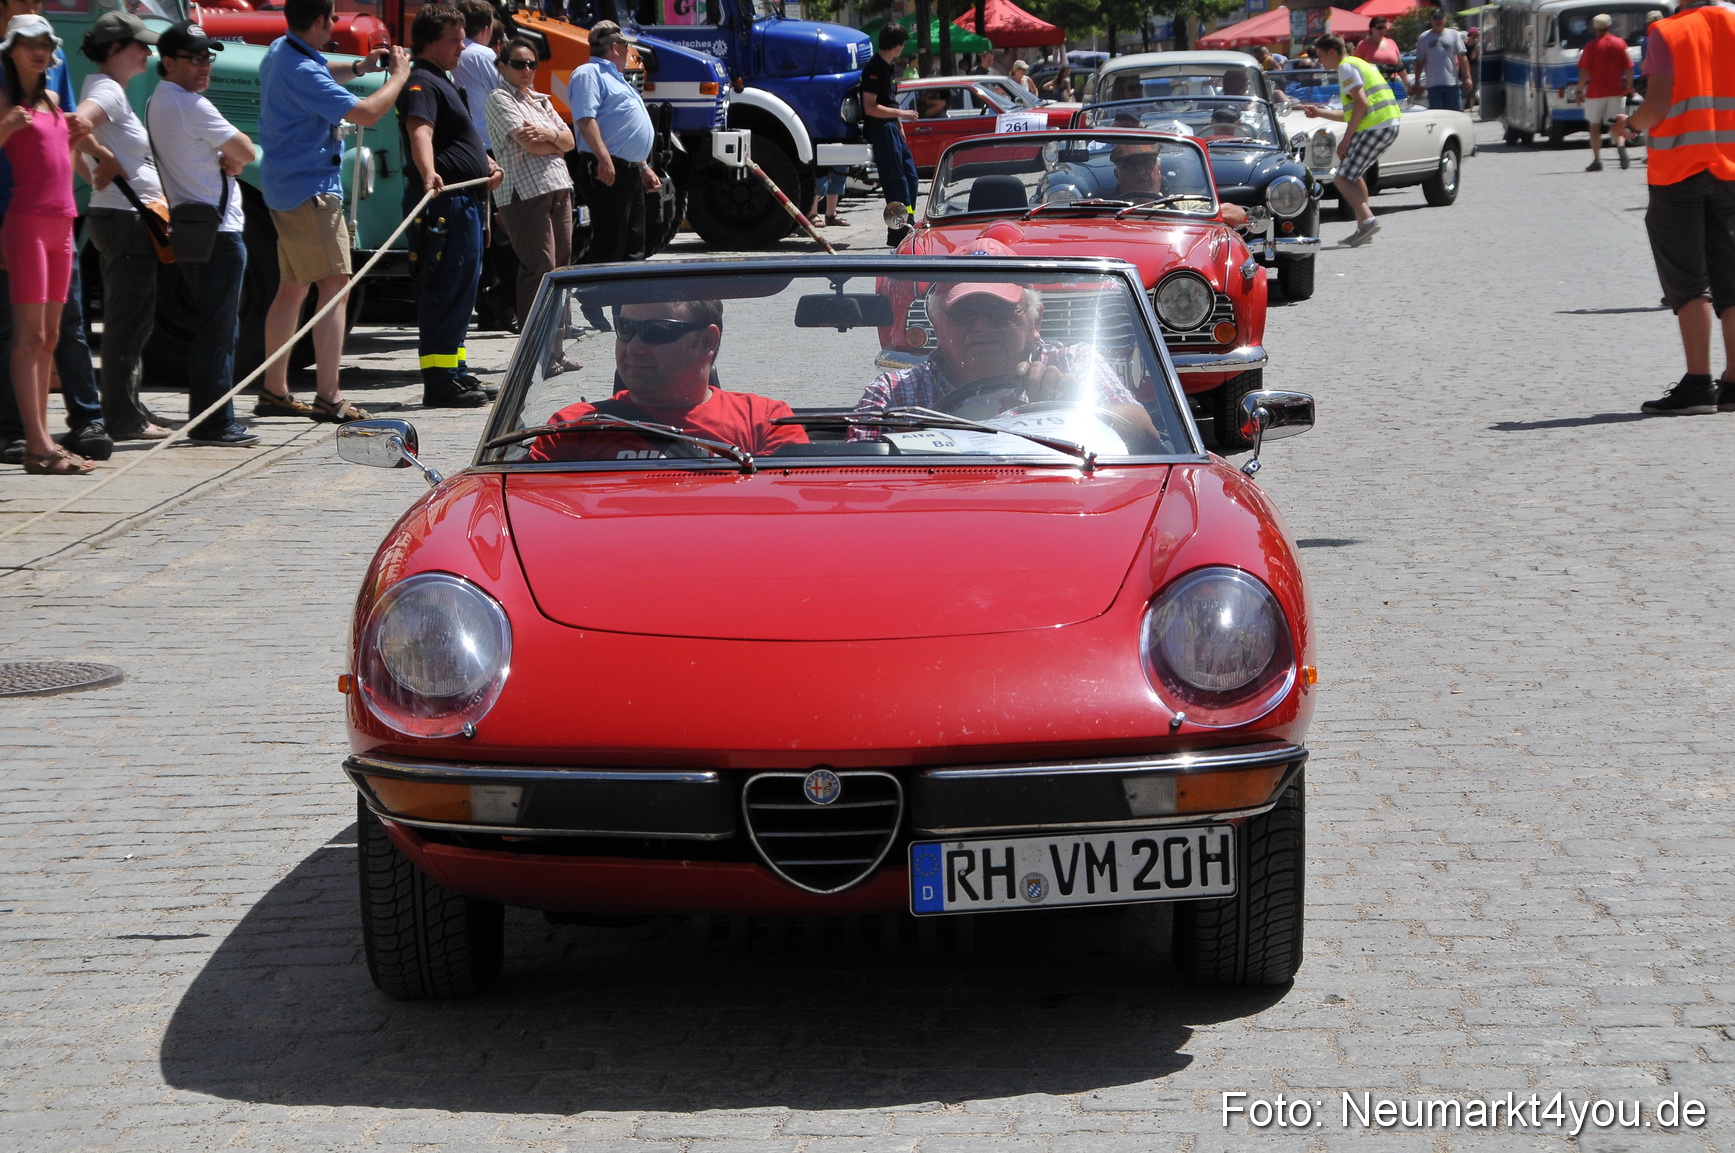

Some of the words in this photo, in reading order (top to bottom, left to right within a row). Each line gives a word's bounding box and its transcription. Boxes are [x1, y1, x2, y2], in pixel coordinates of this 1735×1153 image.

[210, 76, 252, 85] Mercedes
[1005, 121, 1029, 133] 261
[946, 846, 1017, 903] RH
[1049, 840, 1119, 896] VM
[1131, 834, 1231, 892] 20H
[922, 885, 934, 901] D
